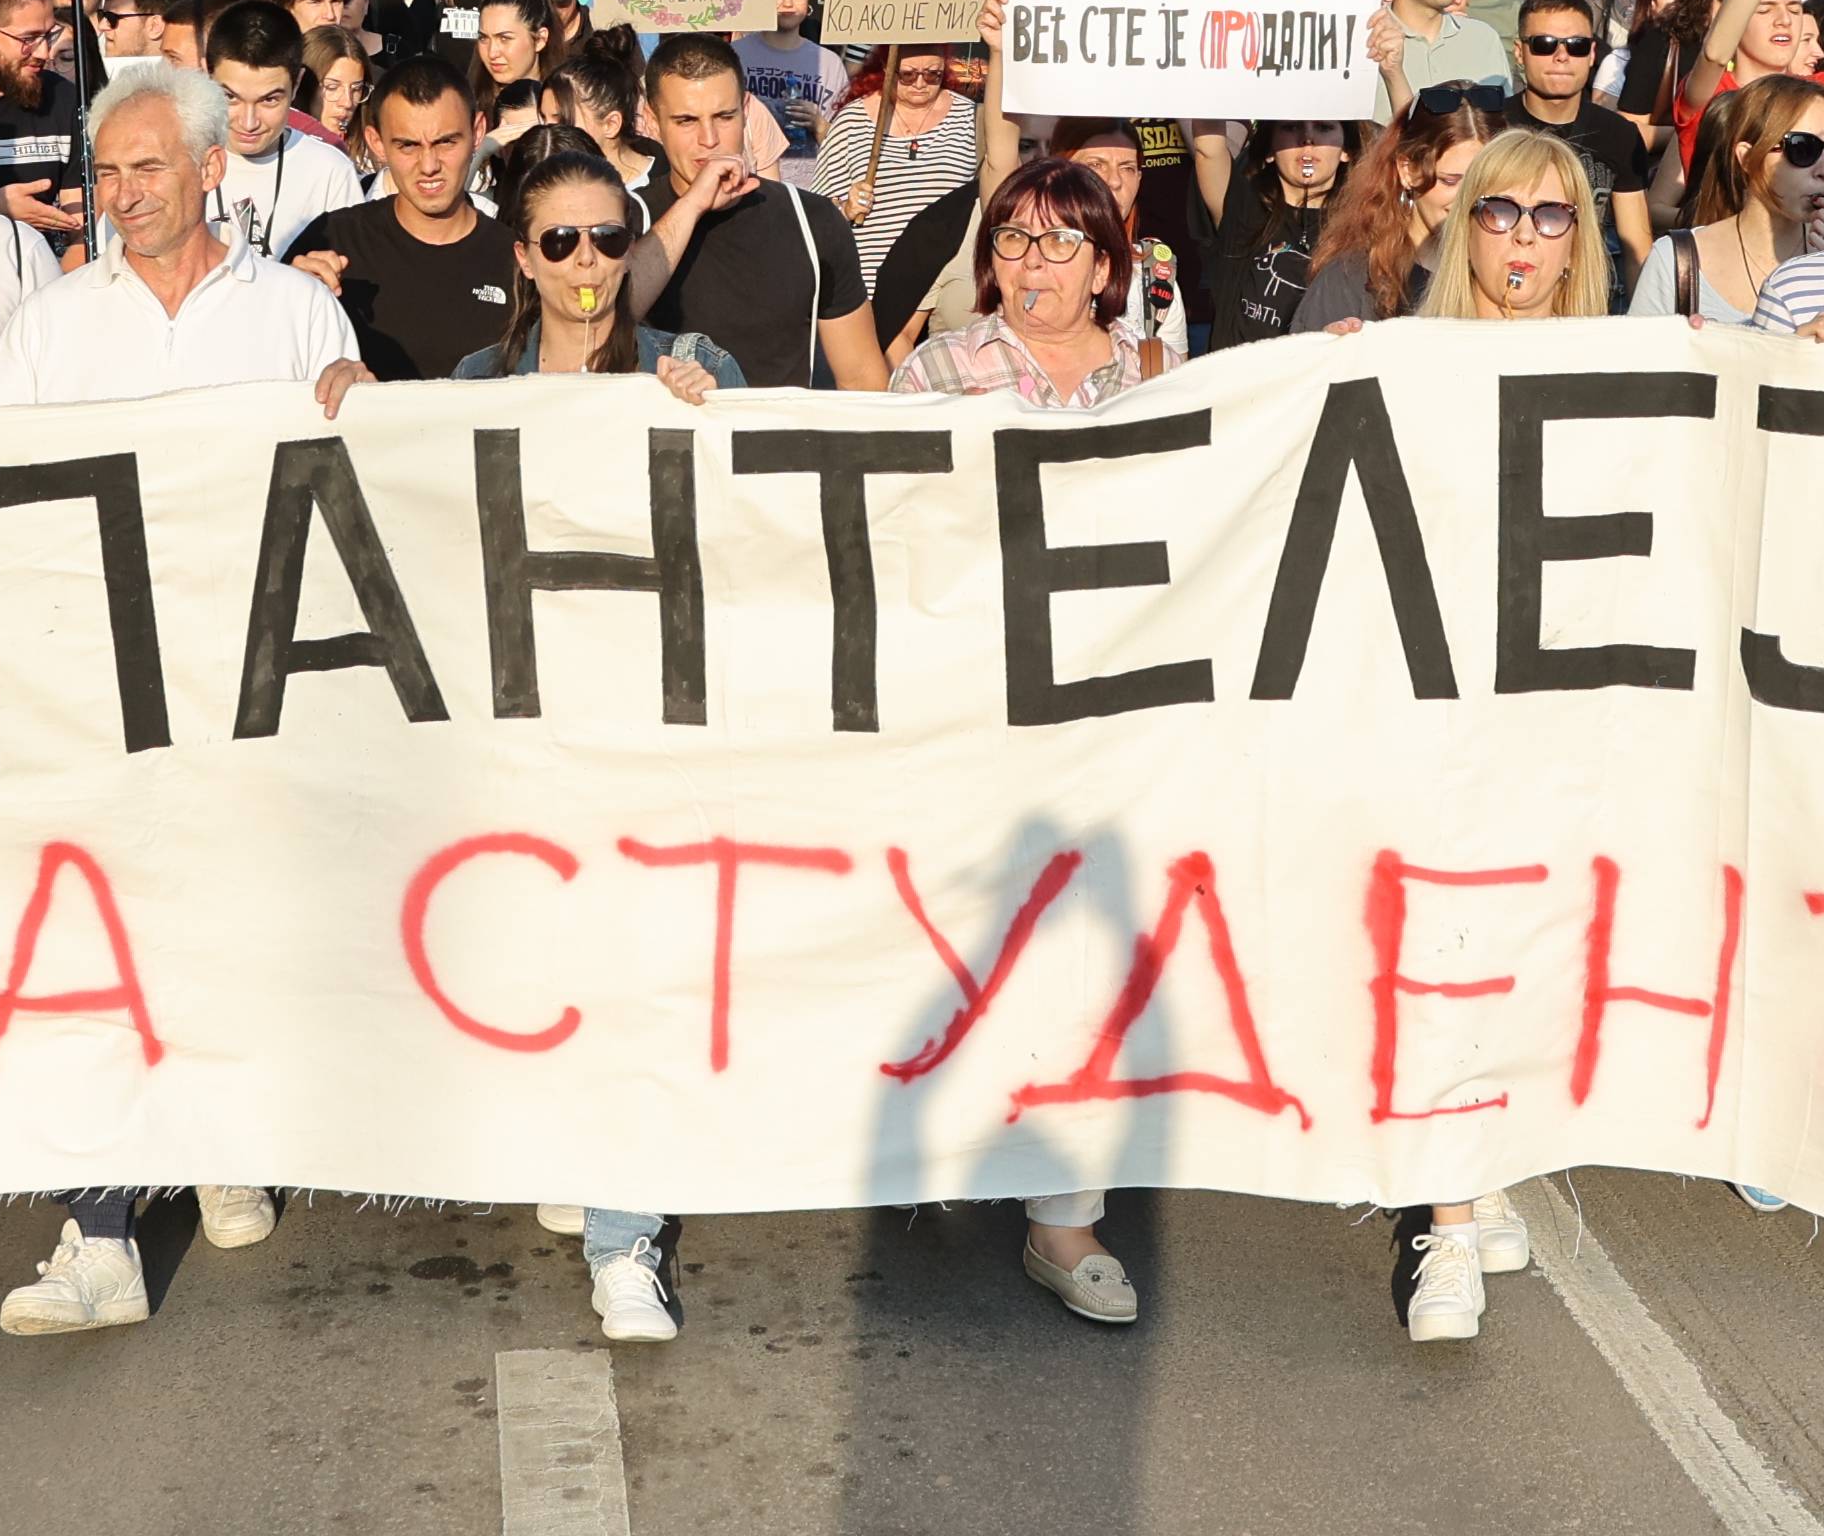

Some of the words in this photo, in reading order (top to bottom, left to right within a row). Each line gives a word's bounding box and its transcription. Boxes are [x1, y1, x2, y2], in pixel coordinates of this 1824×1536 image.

[901, 1, 929, 31] НЕ
[934, 0, 979, 35] МИ?
[1079, 5, 1146, 67] СТЕ
